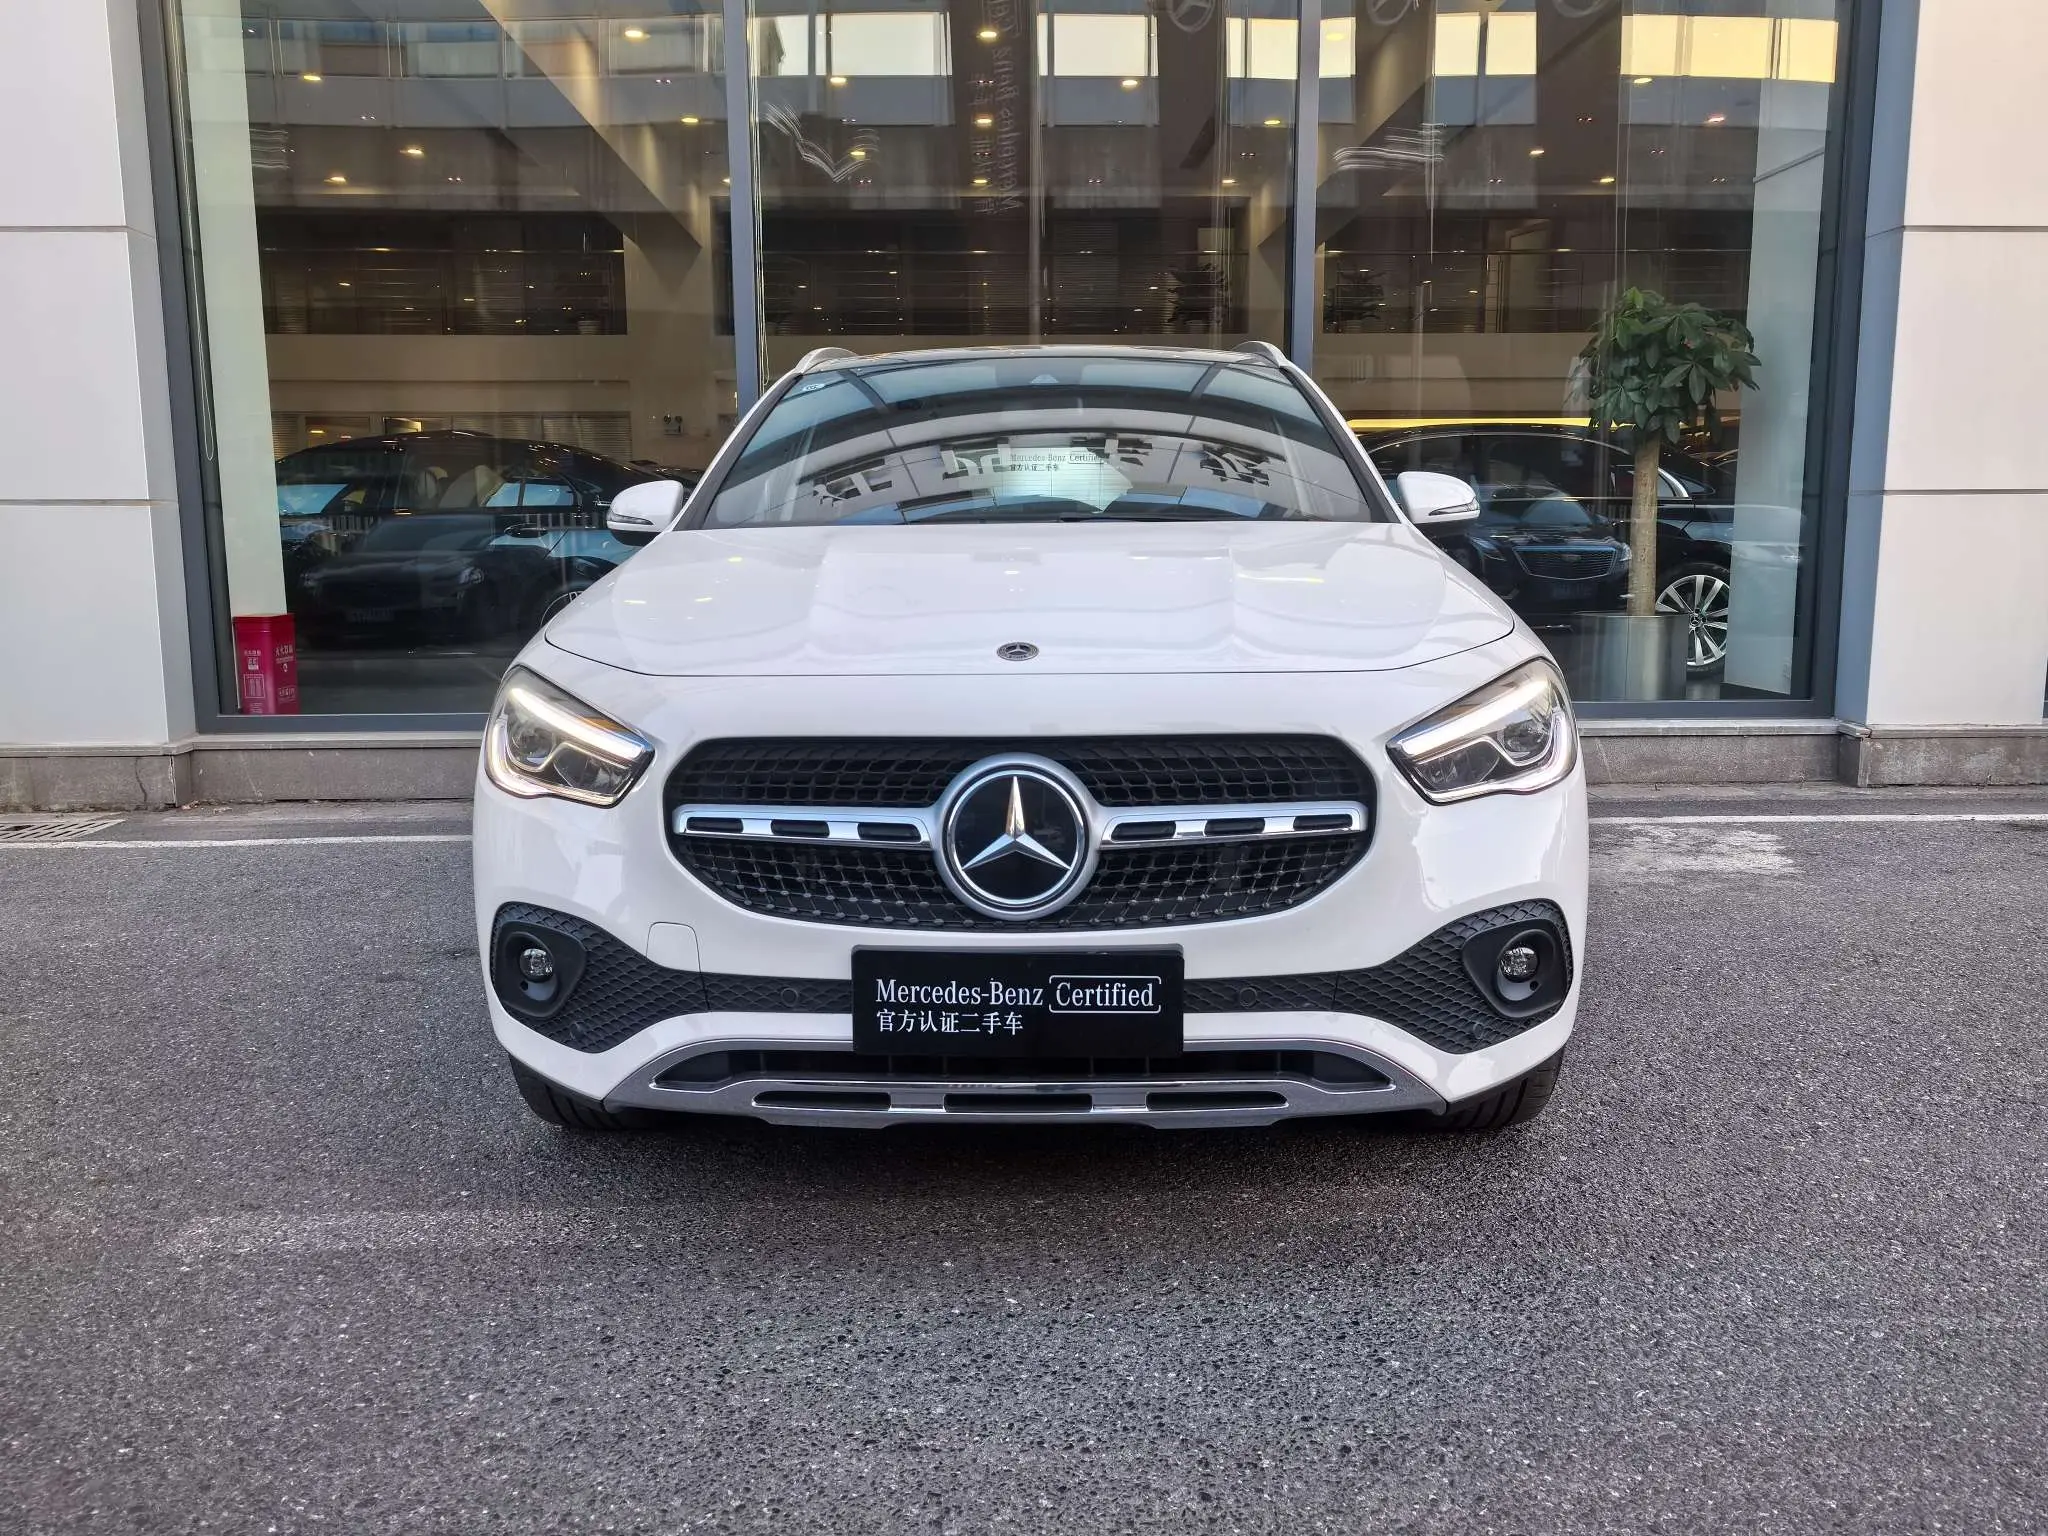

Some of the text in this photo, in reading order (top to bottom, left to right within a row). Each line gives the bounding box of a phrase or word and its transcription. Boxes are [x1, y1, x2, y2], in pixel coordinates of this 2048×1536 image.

[876, 978, 1154, 1007] Mercedes-Benz Certified
[876, 1009, 1024, 1035] 官方认证二手车
